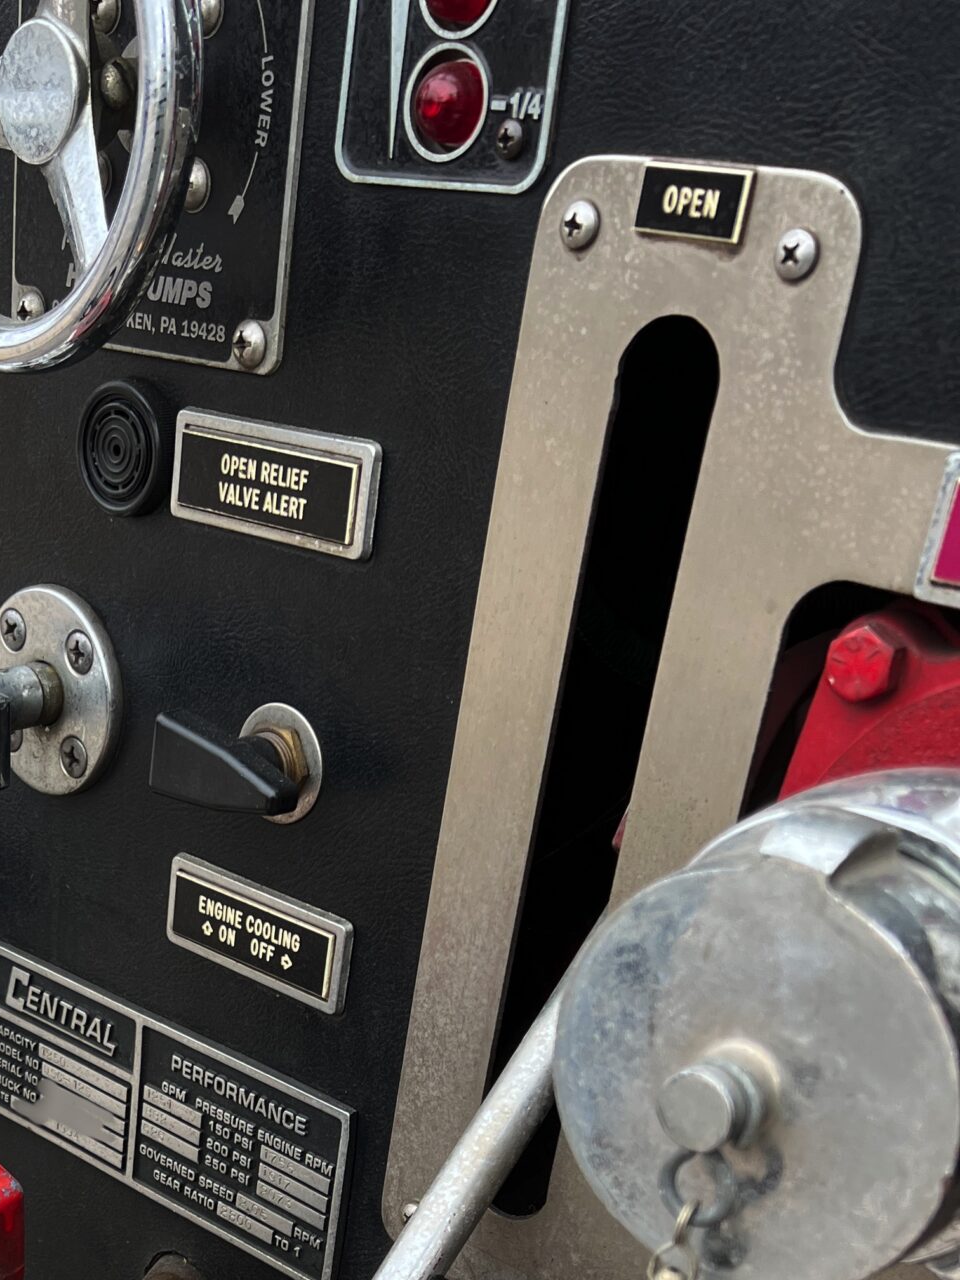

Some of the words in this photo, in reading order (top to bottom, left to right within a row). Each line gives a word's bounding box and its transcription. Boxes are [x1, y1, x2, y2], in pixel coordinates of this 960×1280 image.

[254, 55, 275, 148] LOWER
[662, 184, 721, 219] OPEN
[147, 275, 213, 309] UMPS
[159, 316, 177, 336] PA
[180, 319, 226, 343] 19428
[221, 453, 257, 481] OPEN
[260, 461, 309, 491] RELIEF
[218, 481, 260, 511] VALVE
[262, 491, 307, 520] ALERT
[198, 895, 243, 929] ENGINE
[246, 915, 301, 952] COOLING
[218, 925, 236, 947] ON
[250, 938, 275, 962] OFF
[5, 966, 118, 1056] CENTRAL
[171, 1054, 309, 1136] PERFORMANCE
[161, 1081, 186, 1102] GPM
[195, 1097, 254, 1136] PRESSURE
[257, 1129, 301, 1160] ENGINE
[305, 1152, 333, 1177] RPM
[208, 1120, 230, 1139] 150
[234, 1135, 253, 1151] PSI
[204, 1154, 227, 1174] 250
[230, 1170, 250, 1186] PSI
[206, 1137, 229, 1157] 200
[232, 1152, 251, 1169] PSI
[140, 1144, 195, 1182] GOVERNED
[198, 1175, 234, 1203] SPEED
[294, 1227, 323, 1250] RPM
[153, 1169, 181, 1193] GEAR
[184, 1187, 215, 1211] RATIO
[275, 1234, 289, 1251] TO
[294, 1244, 303, 1258] 1
